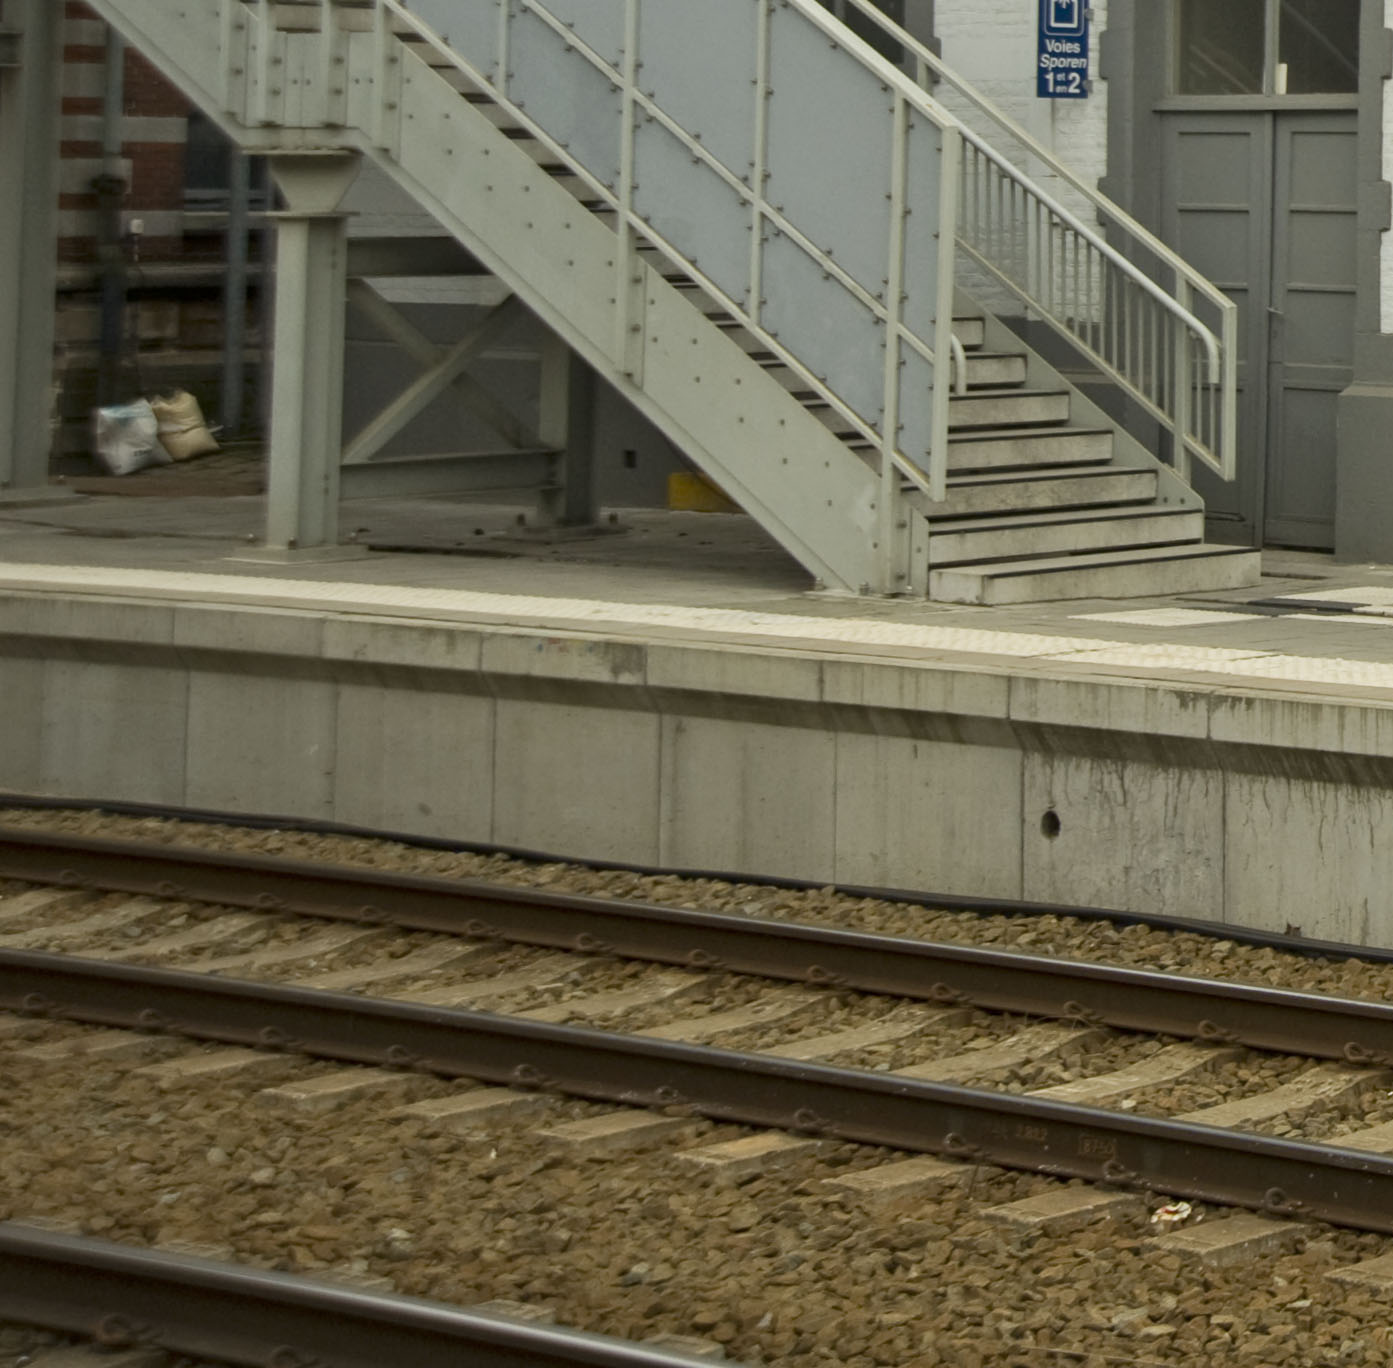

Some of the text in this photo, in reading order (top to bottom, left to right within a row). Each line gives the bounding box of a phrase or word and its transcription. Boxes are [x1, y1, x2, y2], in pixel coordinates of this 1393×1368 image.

[1045, 39, 1081, 53] Voies
[1040, 54, 1087, 71] Sporen
[1044, 72, 1081, 94] 1 et 2
